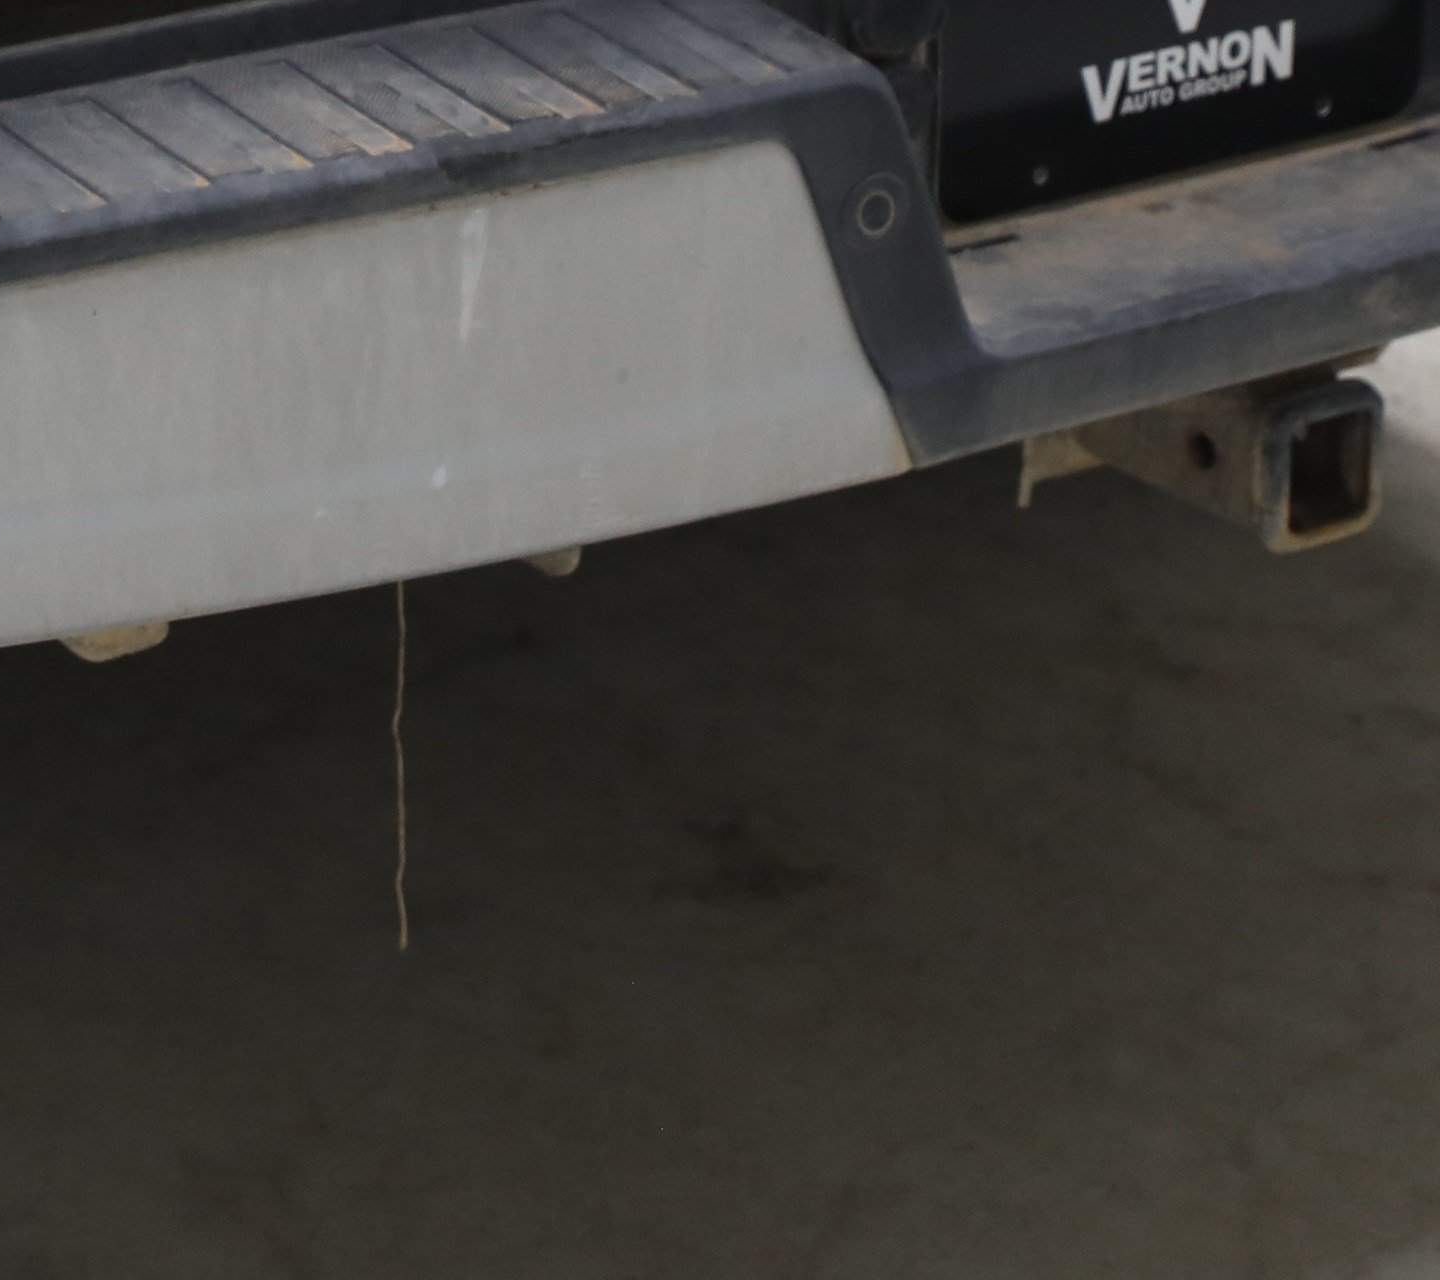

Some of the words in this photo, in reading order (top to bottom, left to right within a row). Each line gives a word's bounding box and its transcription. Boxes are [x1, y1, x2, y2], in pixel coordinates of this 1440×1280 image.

[1081, 19, 1296, 124] VERNON
[1120, 85, 1175, 116] AUTO
[1177, 69, 1248, 102] GROUP
